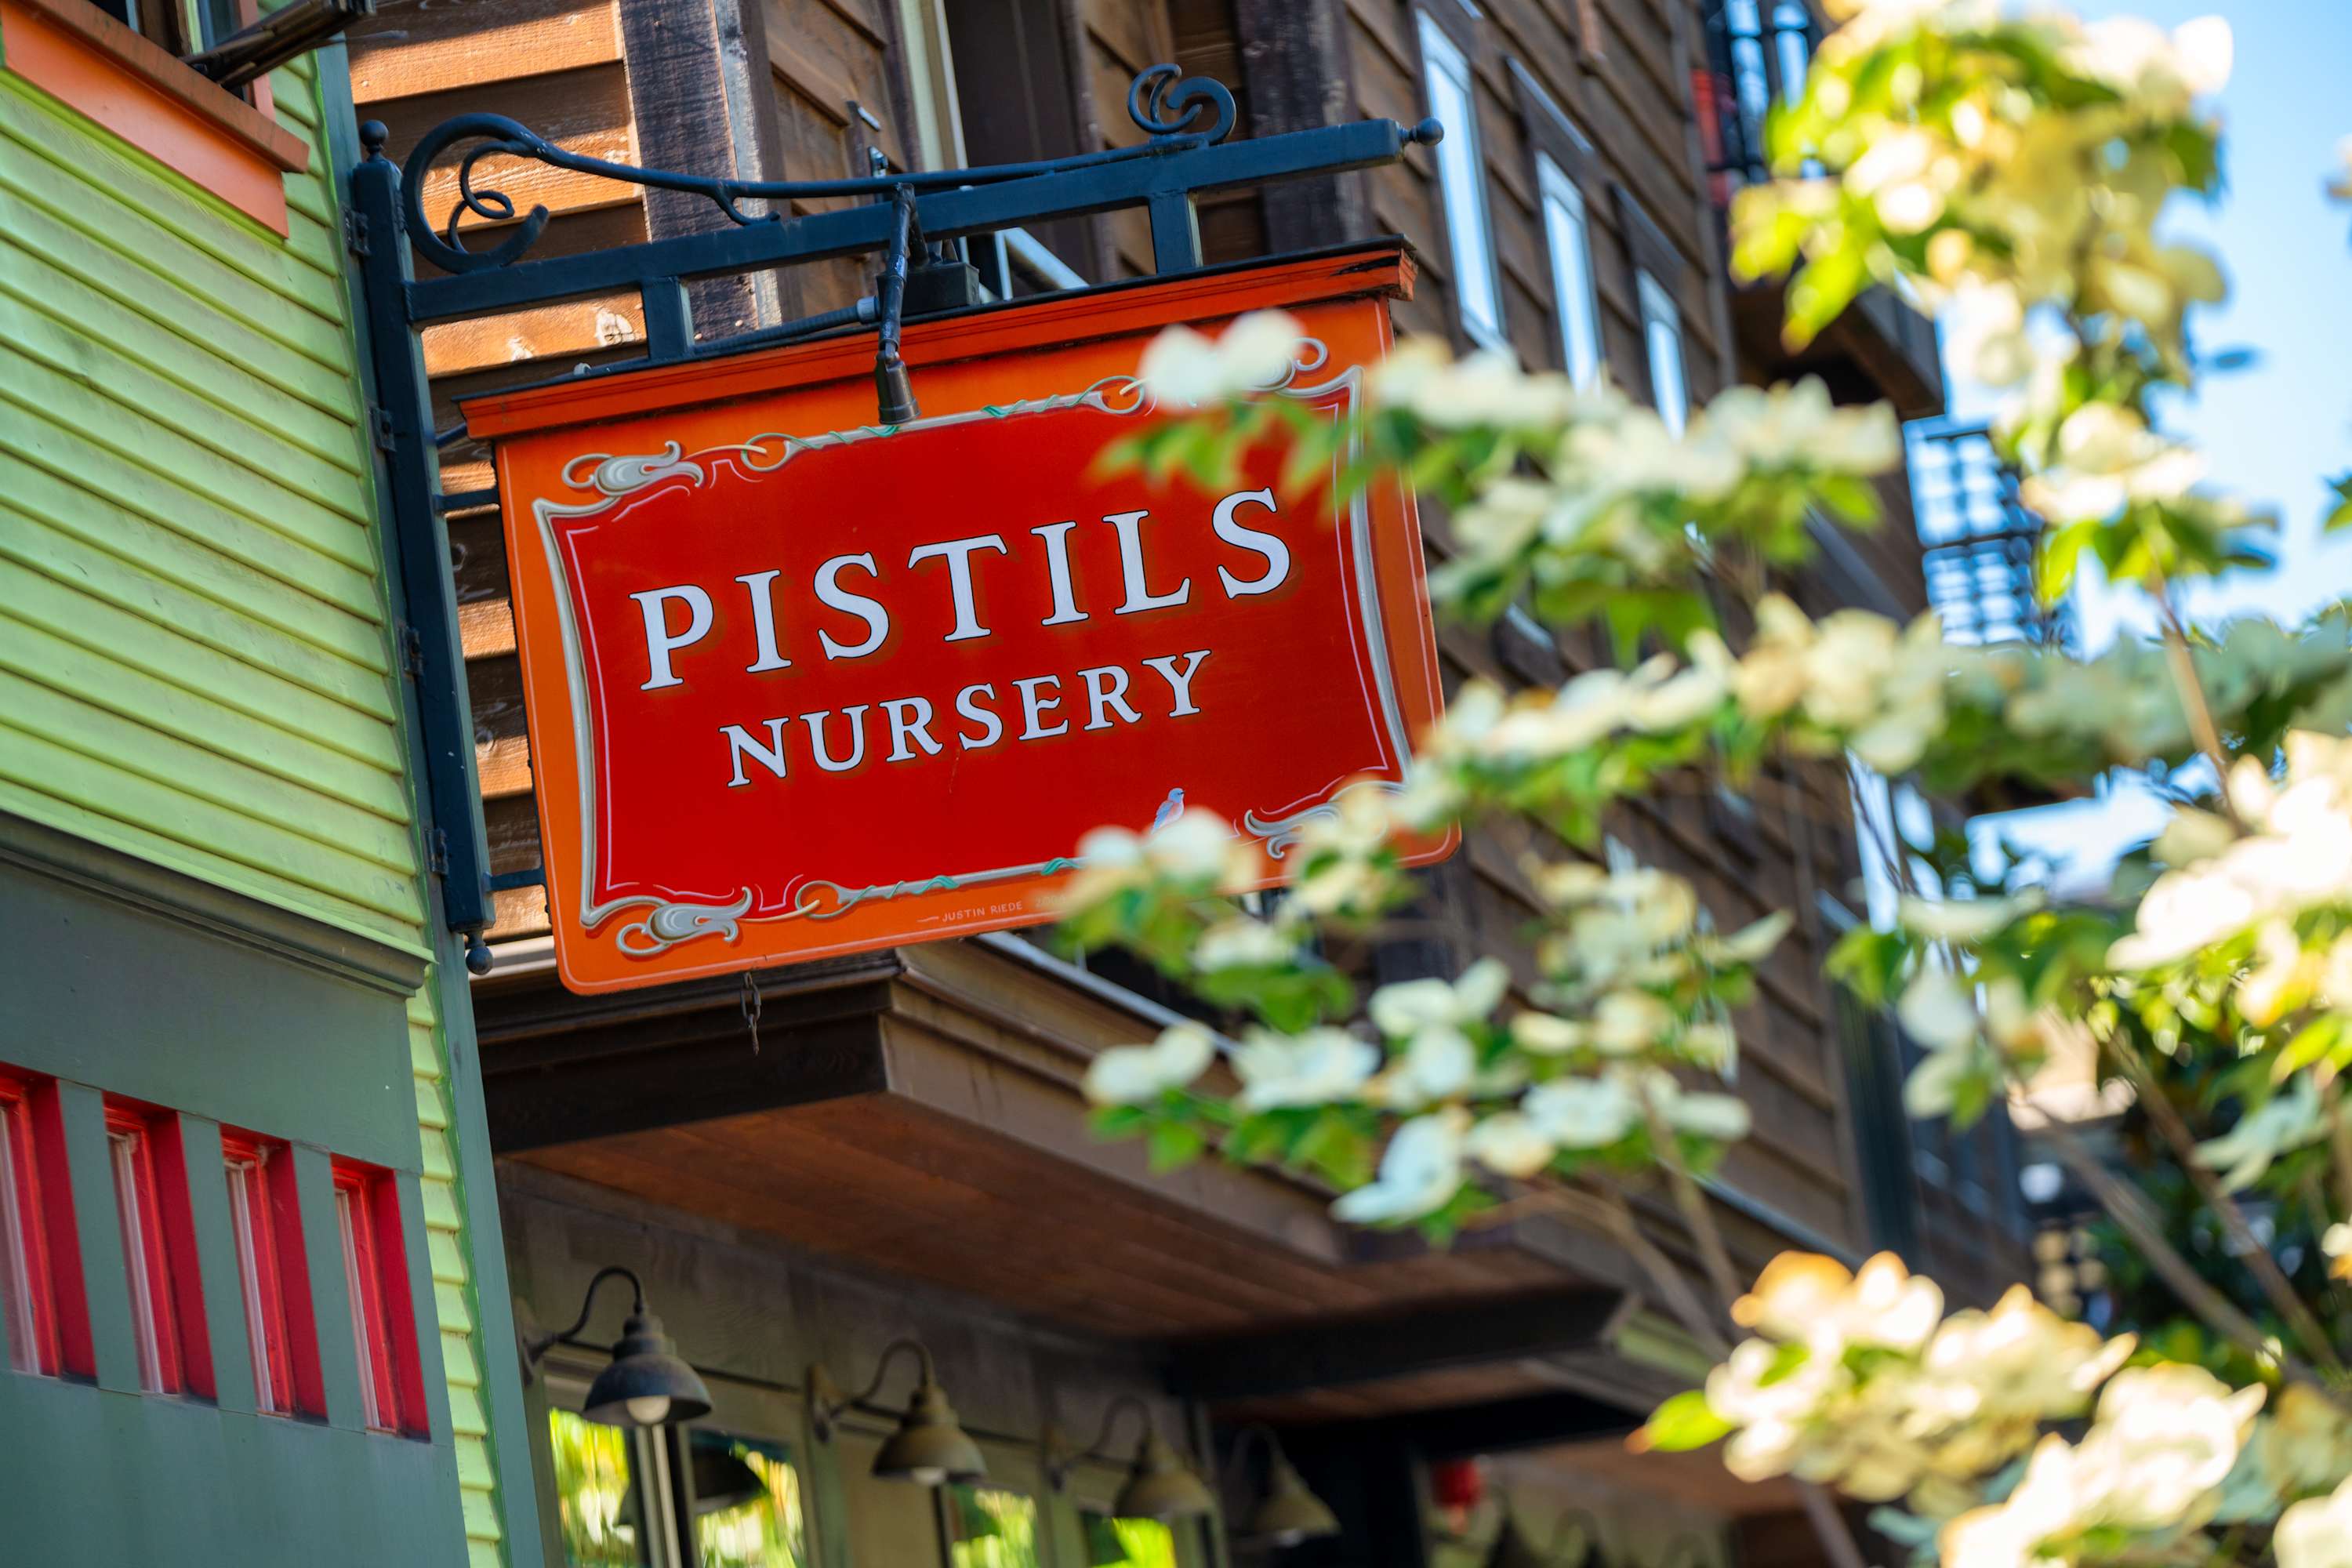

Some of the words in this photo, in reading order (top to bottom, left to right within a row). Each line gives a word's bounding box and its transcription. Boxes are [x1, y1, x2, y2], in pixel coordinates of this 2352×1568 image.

[630, 487, 1290, 691] PISTILS
[719, 650, 1212, 787] NURSERY
[942, 907, 985, 922] JUSTIN
[990, 902, 1022, 915] RIEDE
